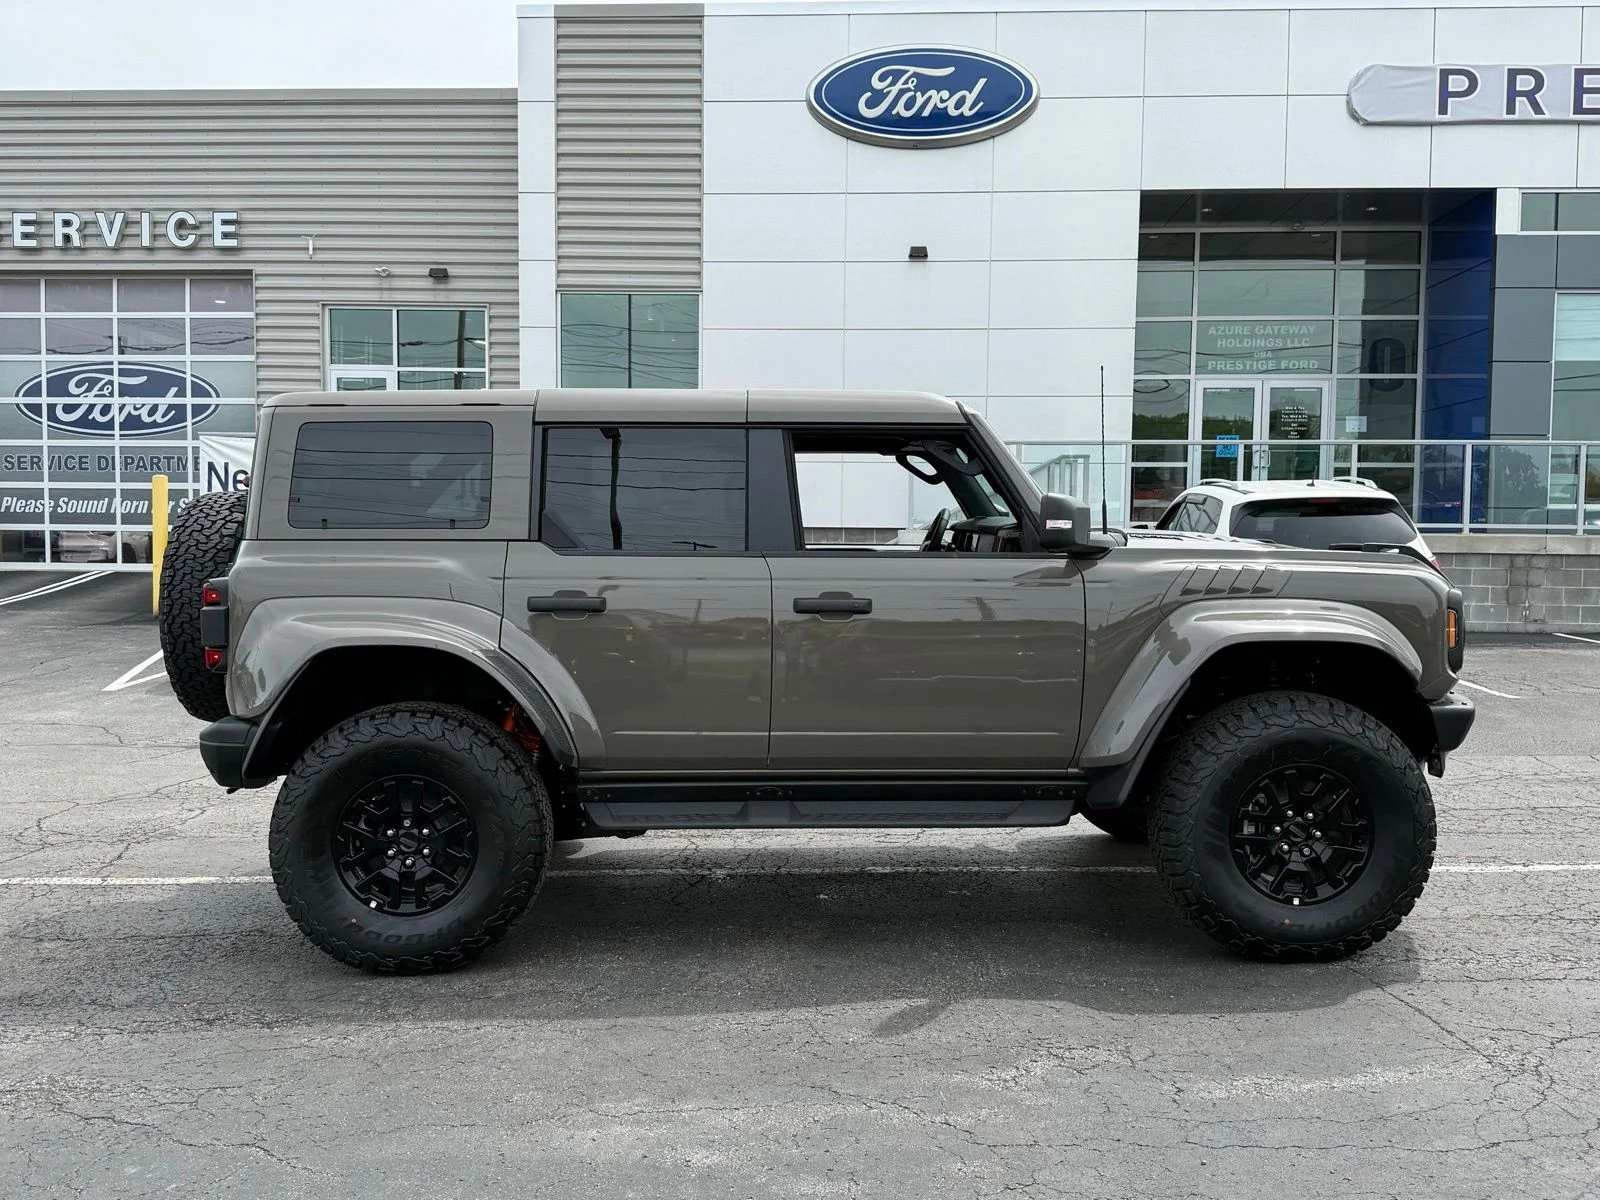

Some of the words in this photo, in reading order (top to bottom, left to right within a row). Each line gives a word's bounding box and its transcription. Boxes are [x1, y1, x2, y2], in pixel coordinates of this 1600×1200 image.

[858, 65, 987, 118] Ford
[1436, 66, 1600, 118] PRE
[0, 210, 240, 248] ERVICE
[1208, 325, 1251, 335] AZURE
[1255, 325, 1316, 335] GATEWAY
[1217, 338, 1283, 348] HOLDINGS
[1287, 337, 1311, 347] LLC
[1207, 360, 1276, 371] PRESTIGE
[1281, 360, 1319, 370] FORD
[55, 373, 178, 423] Ford
[3, 454, 90, 472] SERVICE
[0, 496, 54, 513] Please
[57, 497, 109, 513] Sound
